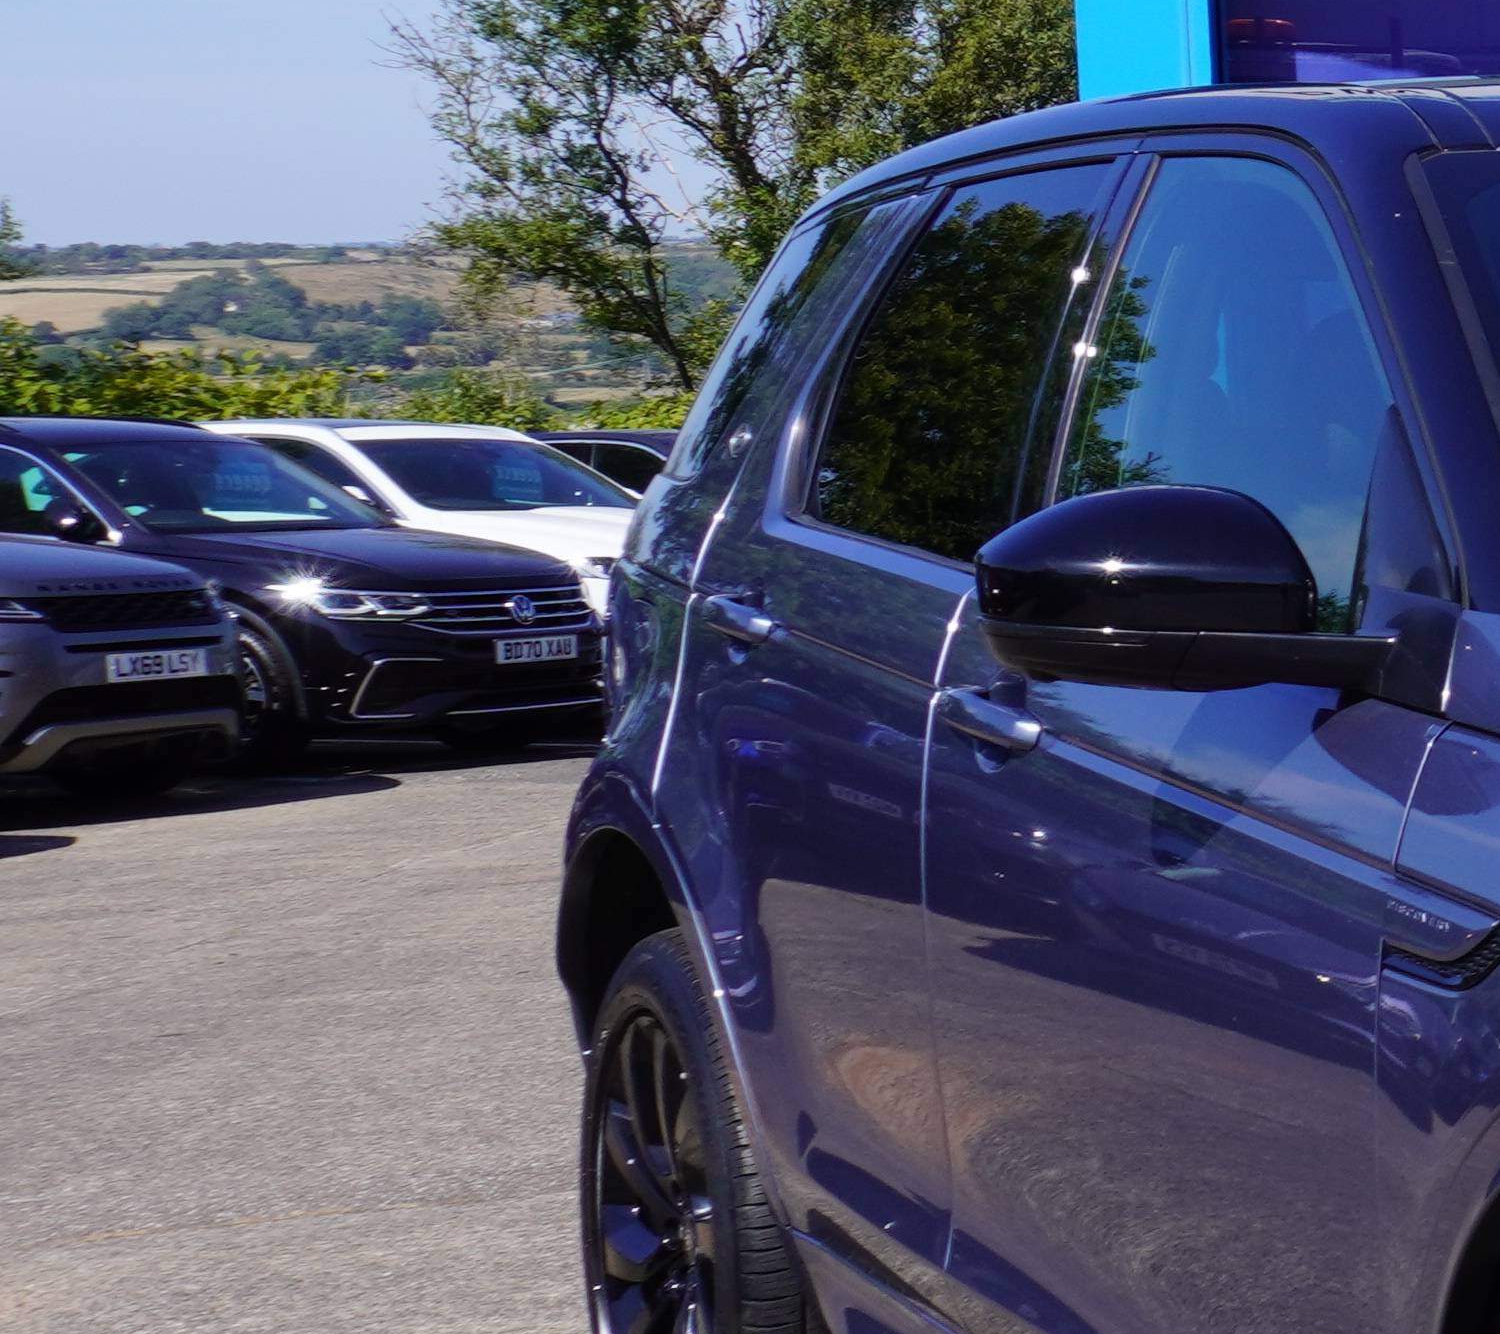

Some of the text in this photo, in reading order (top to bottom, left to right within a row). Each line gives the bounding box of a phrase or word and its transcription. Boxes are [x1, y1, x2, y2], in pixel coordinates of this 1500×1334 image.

[503, 638, 572, 661] BD70 XAU
[114, 653, 199, 677] LX69 LSY
